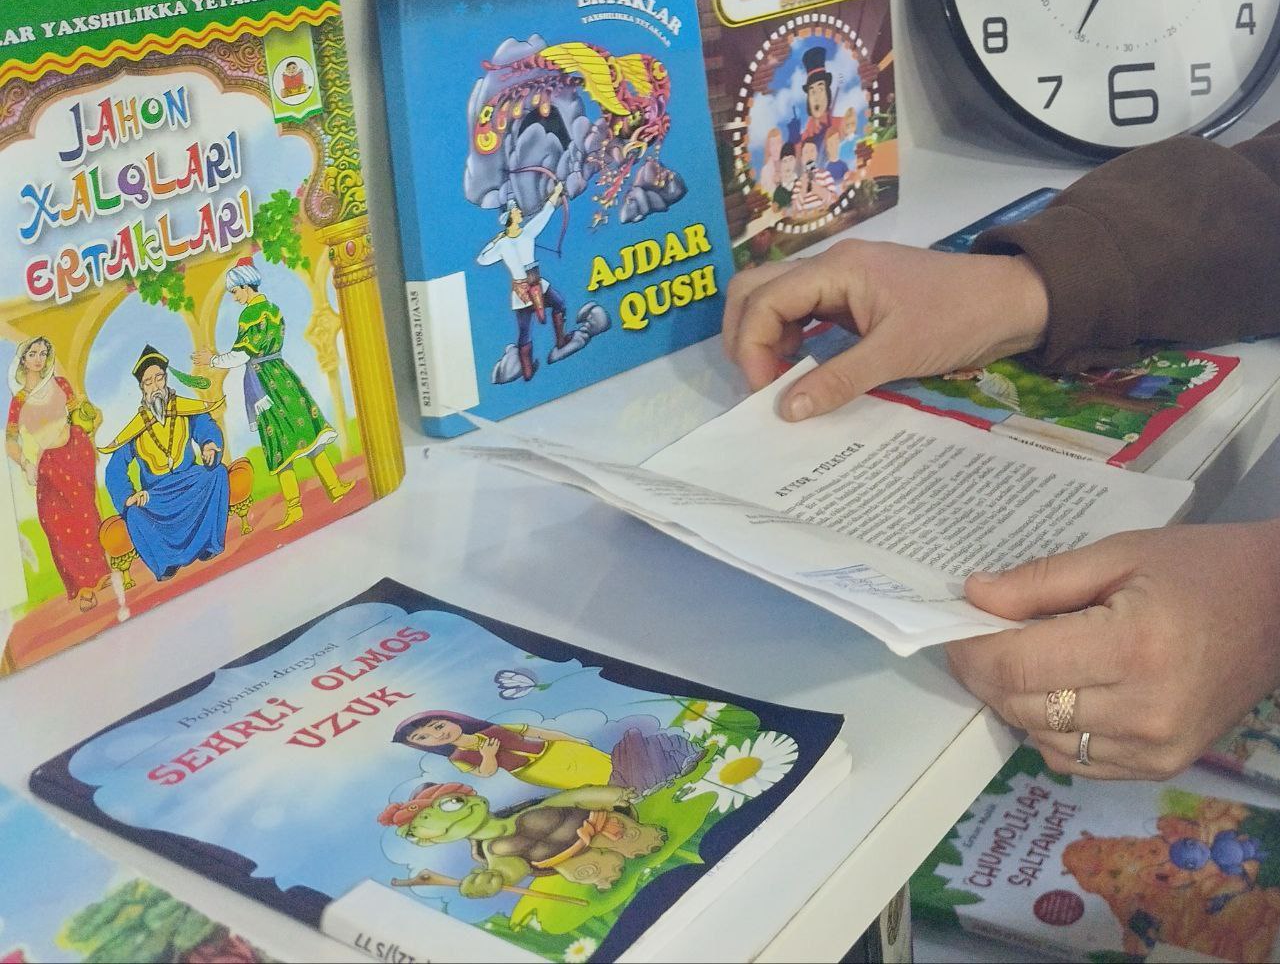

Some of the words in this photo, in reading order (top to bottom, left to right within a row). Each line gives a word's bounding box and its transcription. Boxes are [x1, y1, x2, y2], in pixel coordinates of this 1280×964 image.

[0, 25, 36, 47] AR
[41, 0, 189, 38] YAXSHILIKKA
[982, 16, 1008, 54] 8
[1235, 2, 1257, 36] 4
[1037, 75, 1064, 110] 7
[1107, 62, 1160, 127] 6
[1190, 62, 1213, 97] 5
[59, 85, 191, 164] JAHON
[19, 130, 242, 239] XALQLARI
[25, 189, 254, 300] ERTAKLARI
[587, 223, 712, 292] AJDAR
[620, 264, 718, 330] QUSH
[775, 475, 818, 498] AYYOR
[812, 441, 865, 475] TULKICHA
[311, 626, 431, 691] OLMOS
[177, 678, 270, 729] Bolajonim
[286, 686, 415, 748] UZUK
[1007, 799, 1078, 887] SALTANATI
